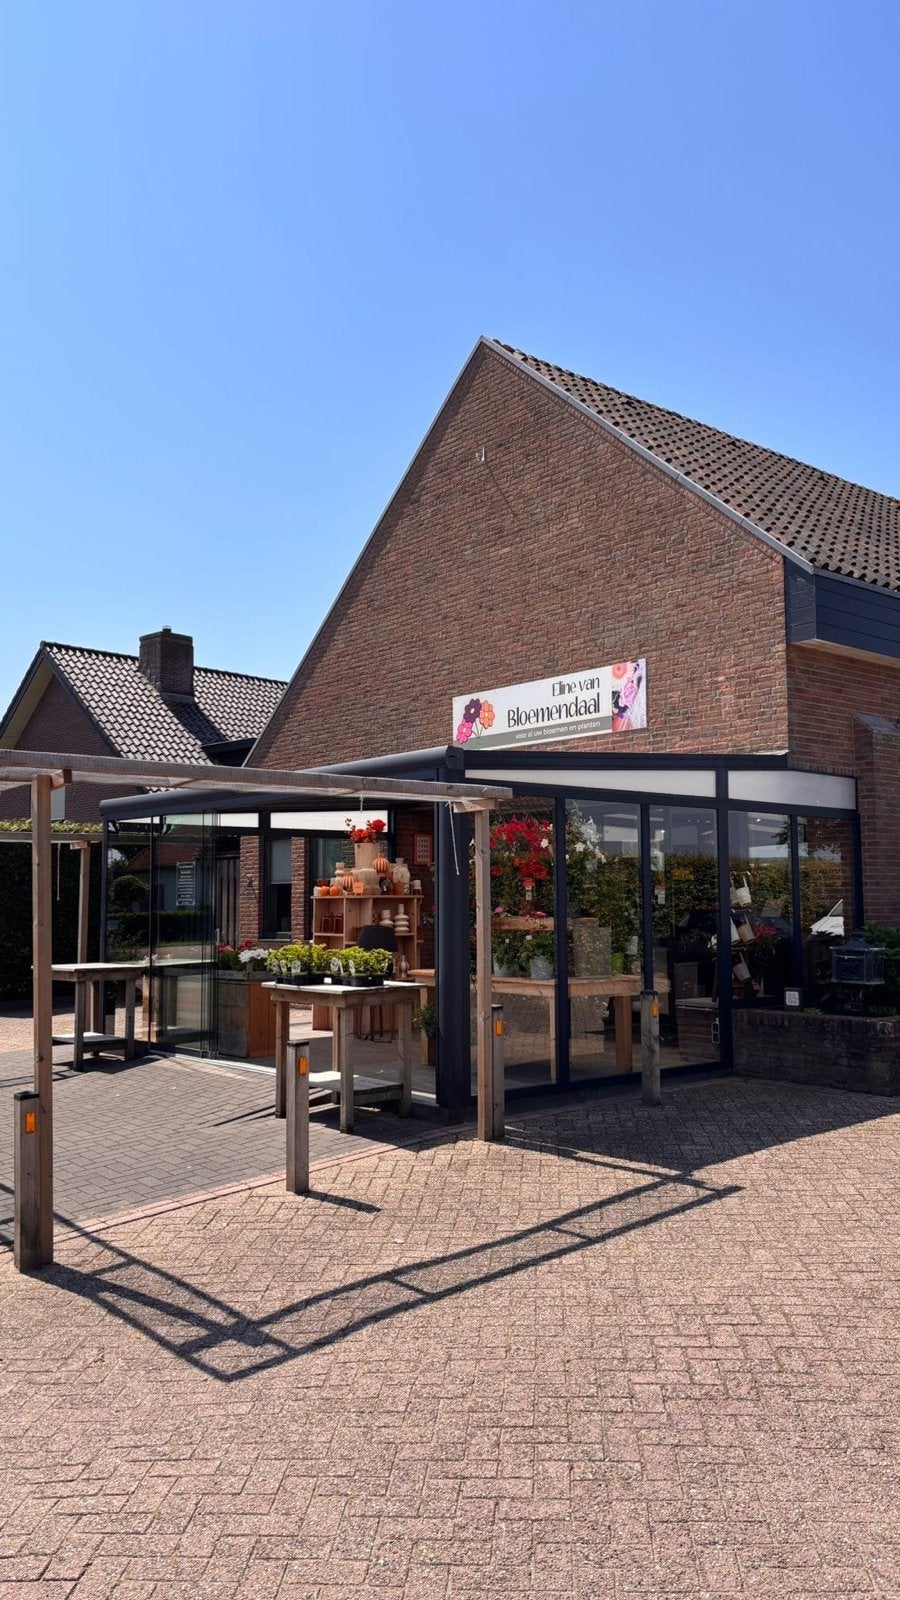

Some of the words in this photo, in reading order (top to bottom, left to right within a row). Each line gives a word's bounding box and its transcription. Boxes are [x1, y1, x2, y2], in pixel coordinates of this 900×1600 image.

[552, 681, 577, 697] Eline
[578, 676, 600, 692] van
[507, 692, 601, 728] Bloemendaal
[515, 731, 527, 740] voor
[543, 725, 568, 736] bloemen
[577, 720, 601, 731] planten
